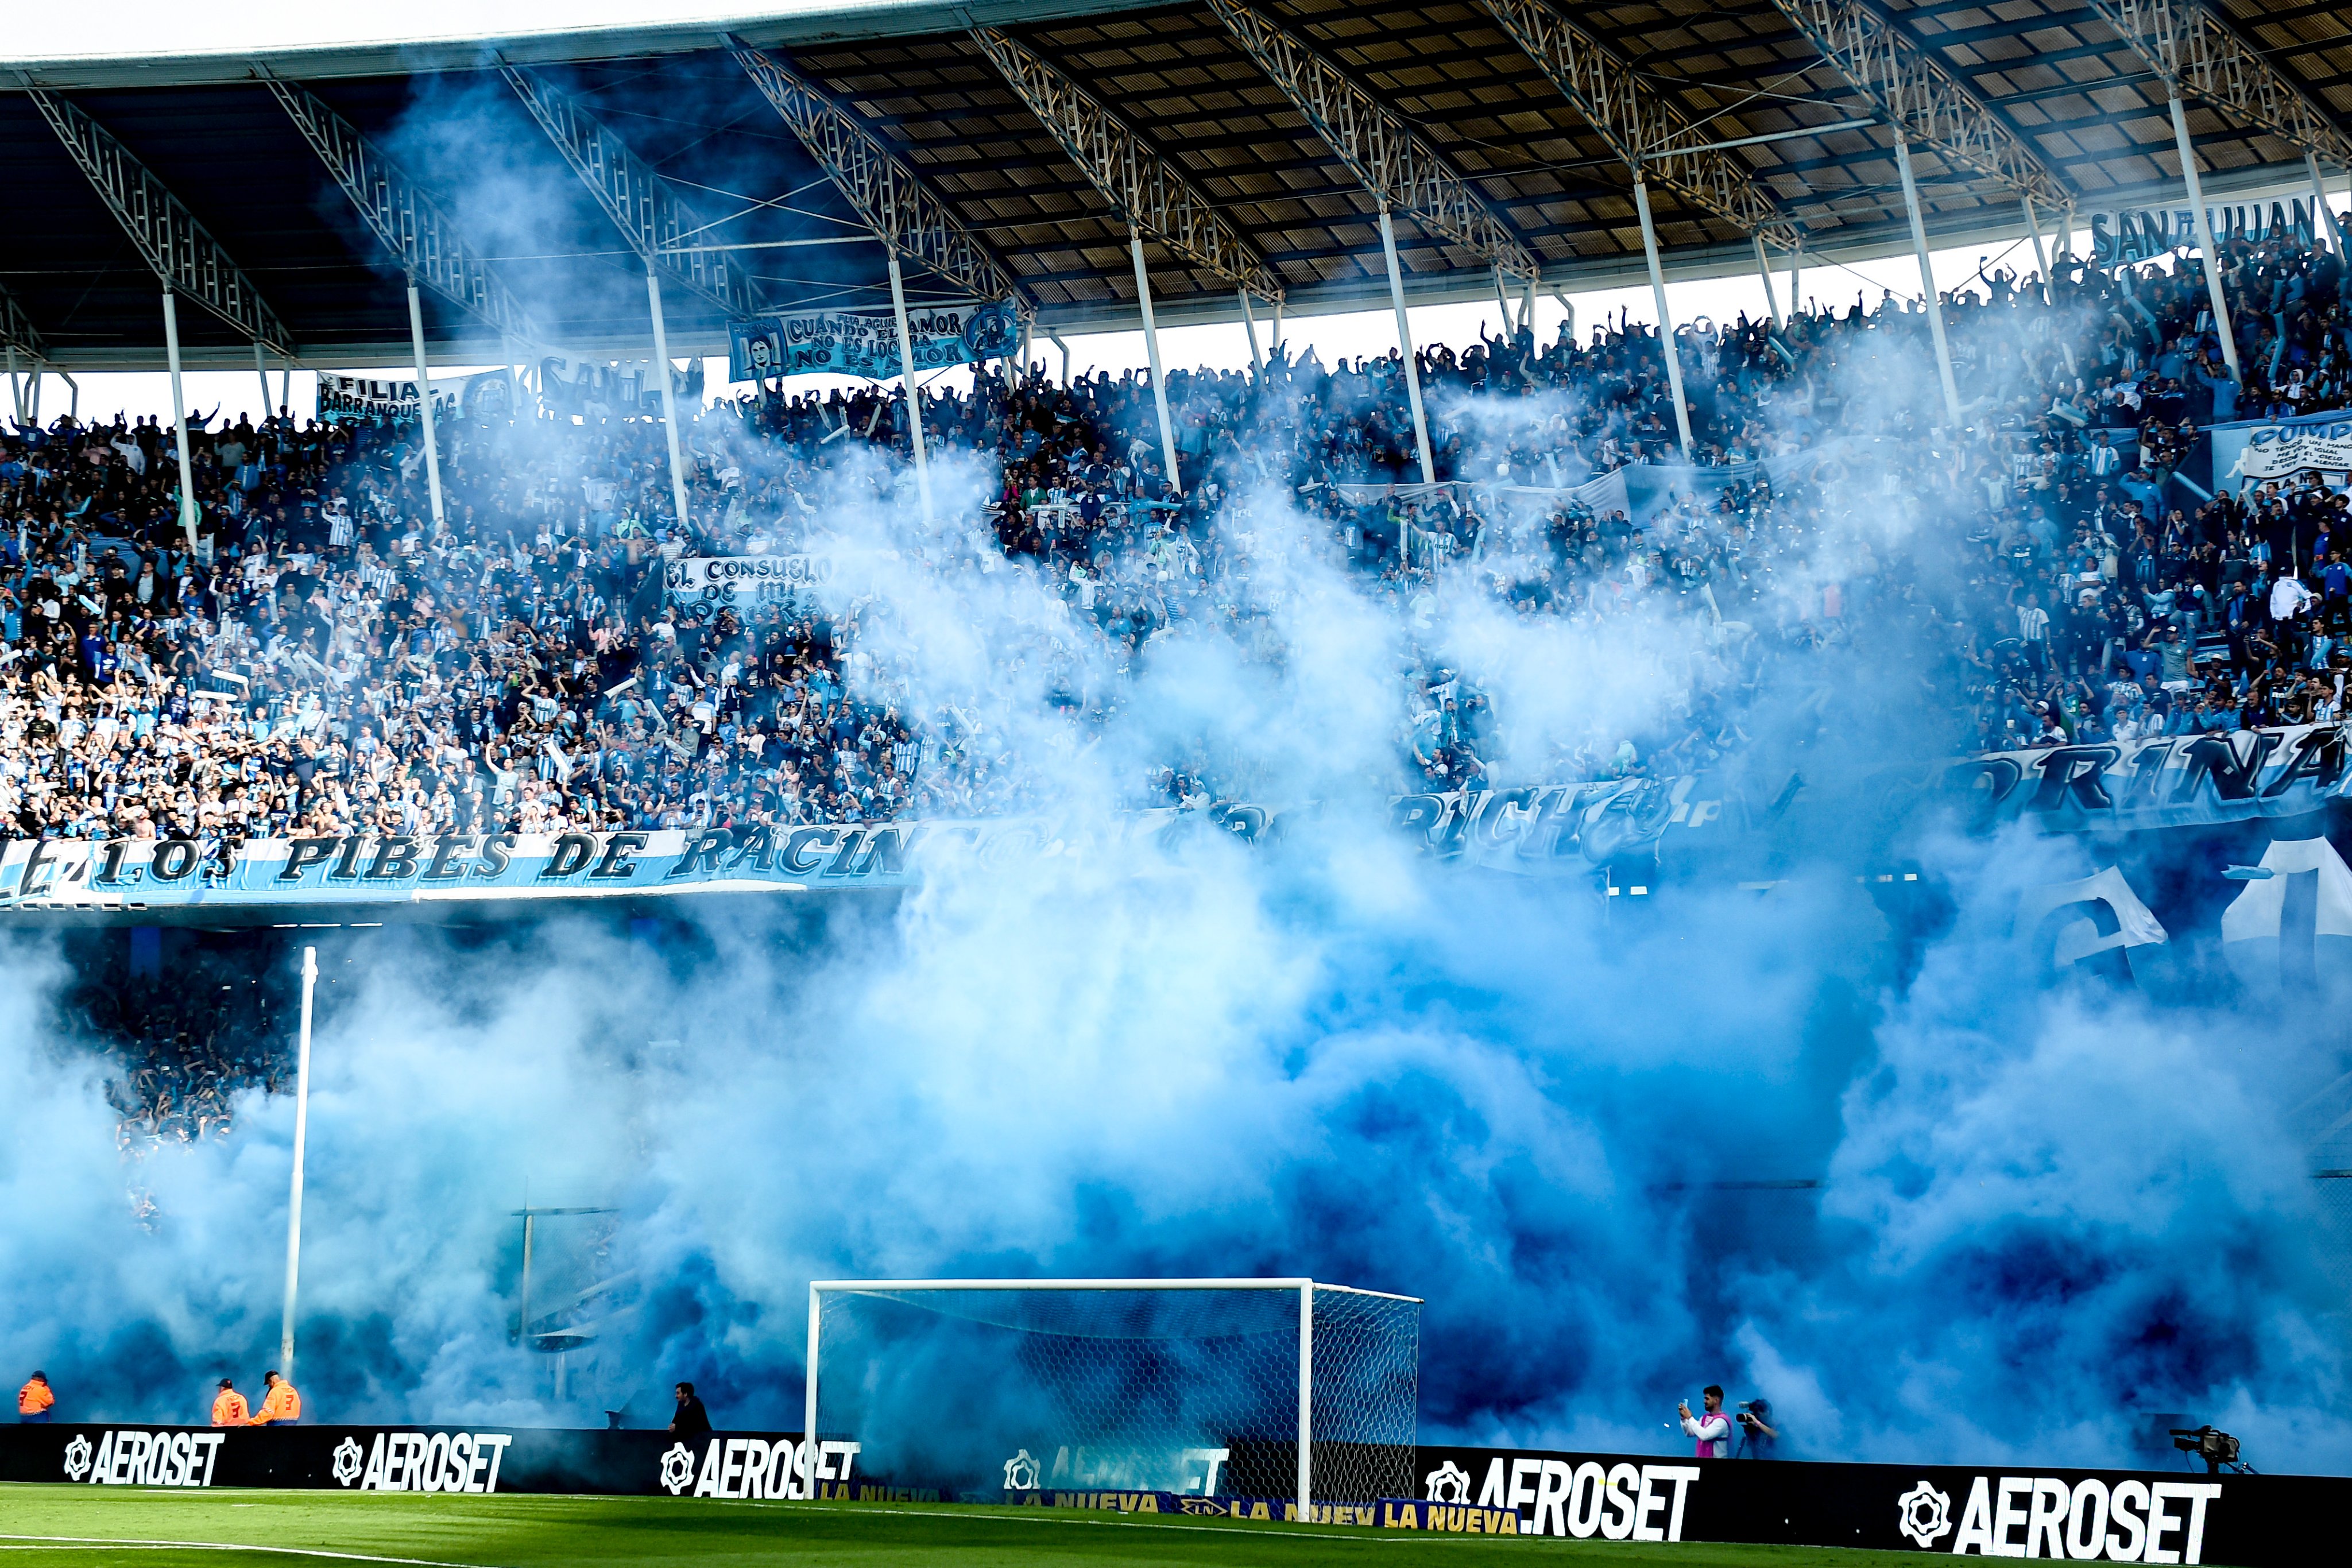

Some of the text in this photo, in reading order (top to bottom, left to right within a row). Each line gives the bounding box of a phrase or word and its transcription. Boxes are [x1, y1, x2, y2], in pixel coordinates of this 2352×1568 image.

[2092, 195, 2315, 263] SAN JUAN
[789, 312, 962, 341] CUANDO EL AMOR
[795, 348, 831, 369] NO
[844, 354, 874, 366] ES
[813, 334, 937, 358] NO ES LOCRA.
[339, 377, 439, 401] FILIA
[2250, 424, 2352, 446] POMP
[2275, 439, 2303, 452] TENGO
[2281, 460, 2297, 469] VOY
[2313, 459, 2350, 467] ALENTAR
[665, 555, 833, 589] EL CONSUELO
[702, 581, 738, 602] DE
[95, 839, 238, 882] LOS
[277, 836, 516, 880] PIBES
[538, 833, 649, 878] DE
[88, 1431, 225, 1486] AEROSET
[360, 1433, 513, 1493] AEROSET
[820, 1482, 850, 1500] LA
[1054, 1493, 1159, 1513] NUEVA
[1477, 1457, 1700, 1542] AEROSET
[1231, 1500, 1376, 1526] LA NUEV
[1384, 1503, 1518, 1535] LA NUEVA
[1952, 1476, 2222, 1565] AEROSET
